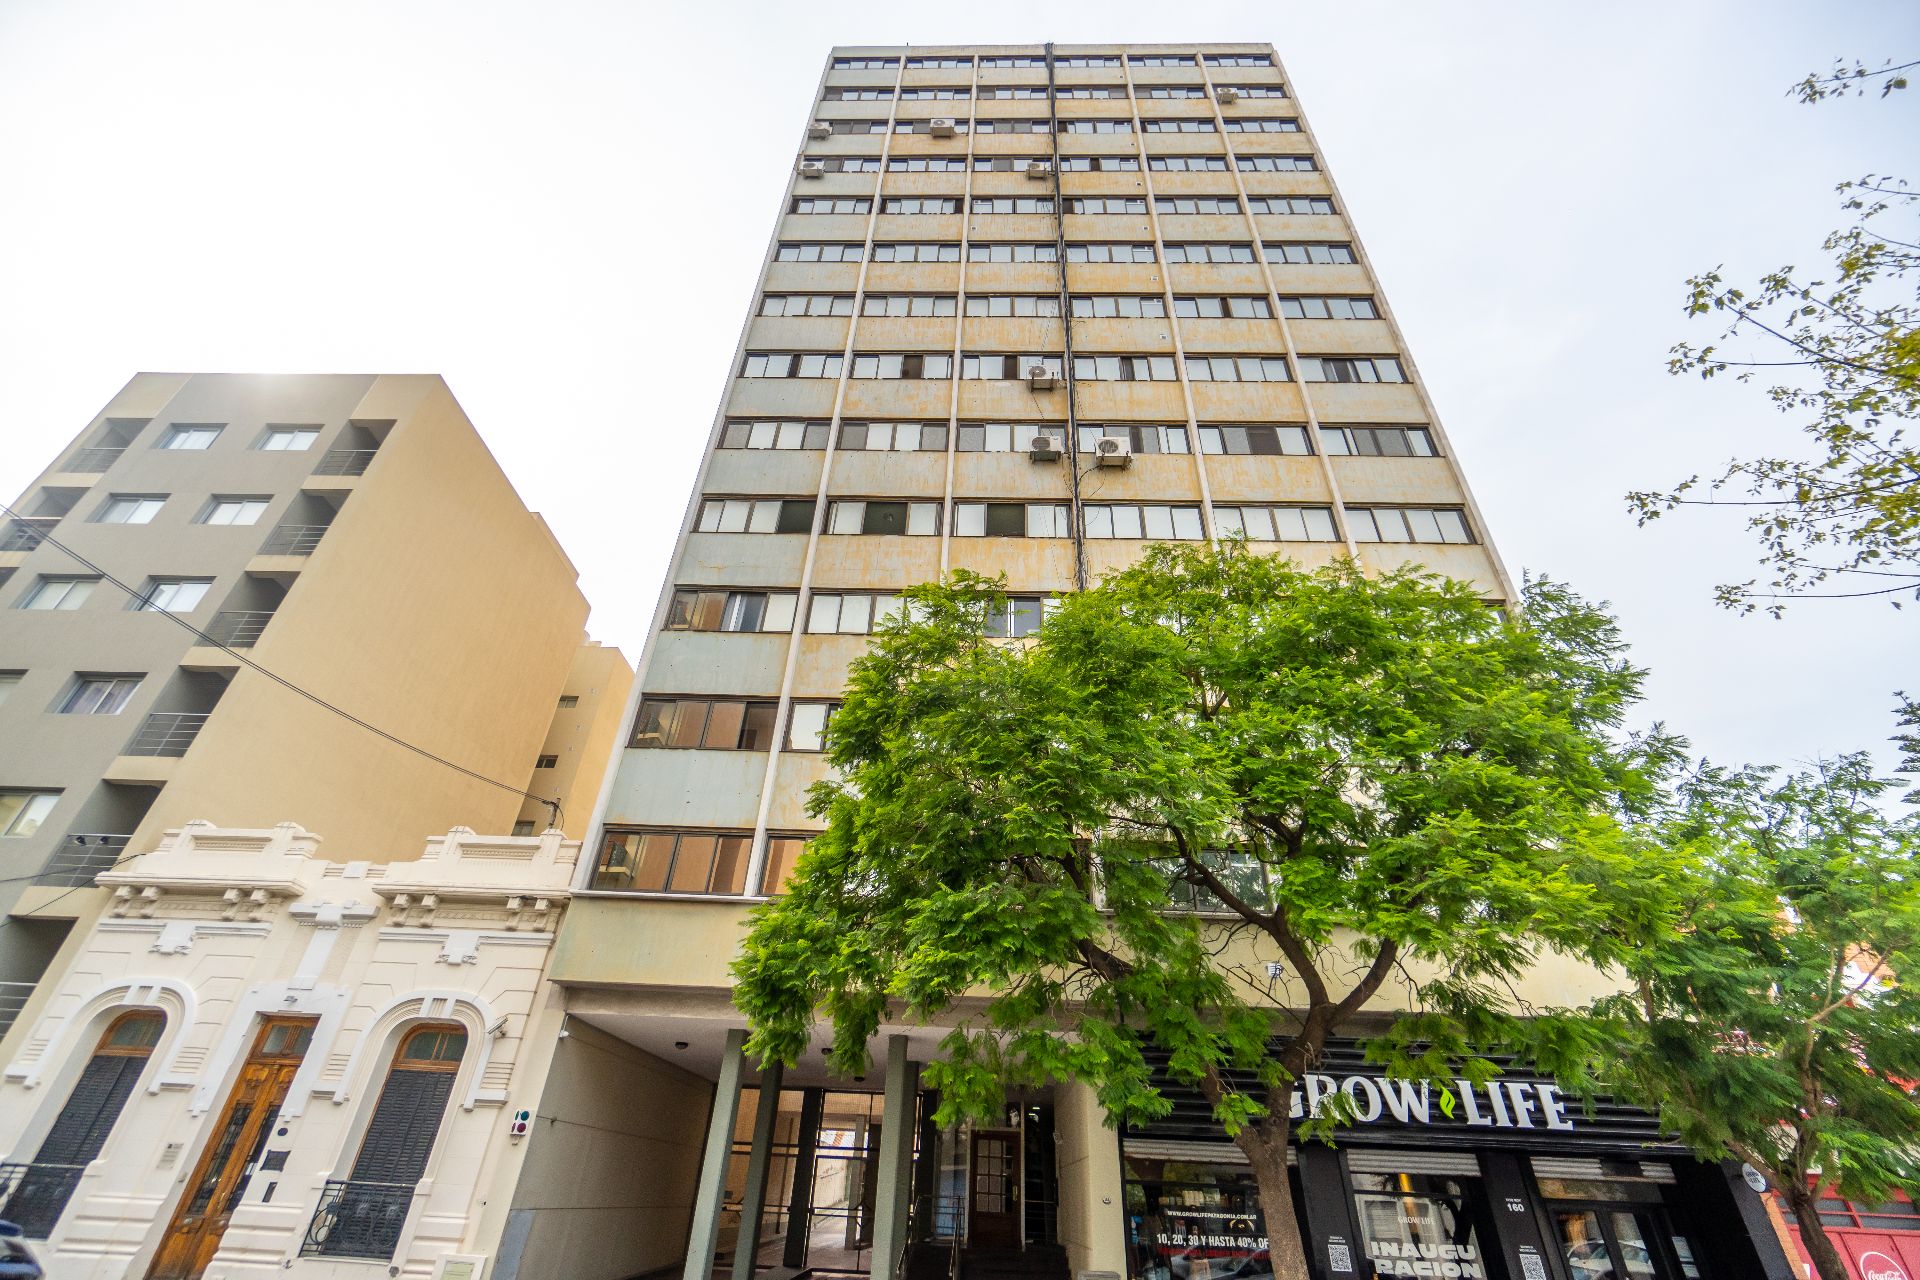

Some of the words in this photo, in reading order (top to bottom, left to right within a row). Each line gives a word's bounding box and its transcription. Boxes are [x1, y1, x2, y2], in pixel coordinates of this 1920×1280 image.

[1455, 1080, 1574, 1131] LIFE
[1507, 1203, 1524, 1212] 160
[1397, 1215, 1420, 1225] GROW
[1156, 1233, 1171, 1246] 10,
[1172, 1234, 1187, 1247] 20,
[1188, 1235, 1199, 1245] 30
[1201, 1235, 1207, 1246] Y
[1208, 1236, 1236, 1248] HASTA
[1237, 1236, 1257, 1248] 40%
[1258, 1237, 1269, 1249] OF
[1370, 1241, 1476, 1260] INAUGU
[1374, 1258, 1483, 1279] RACION
